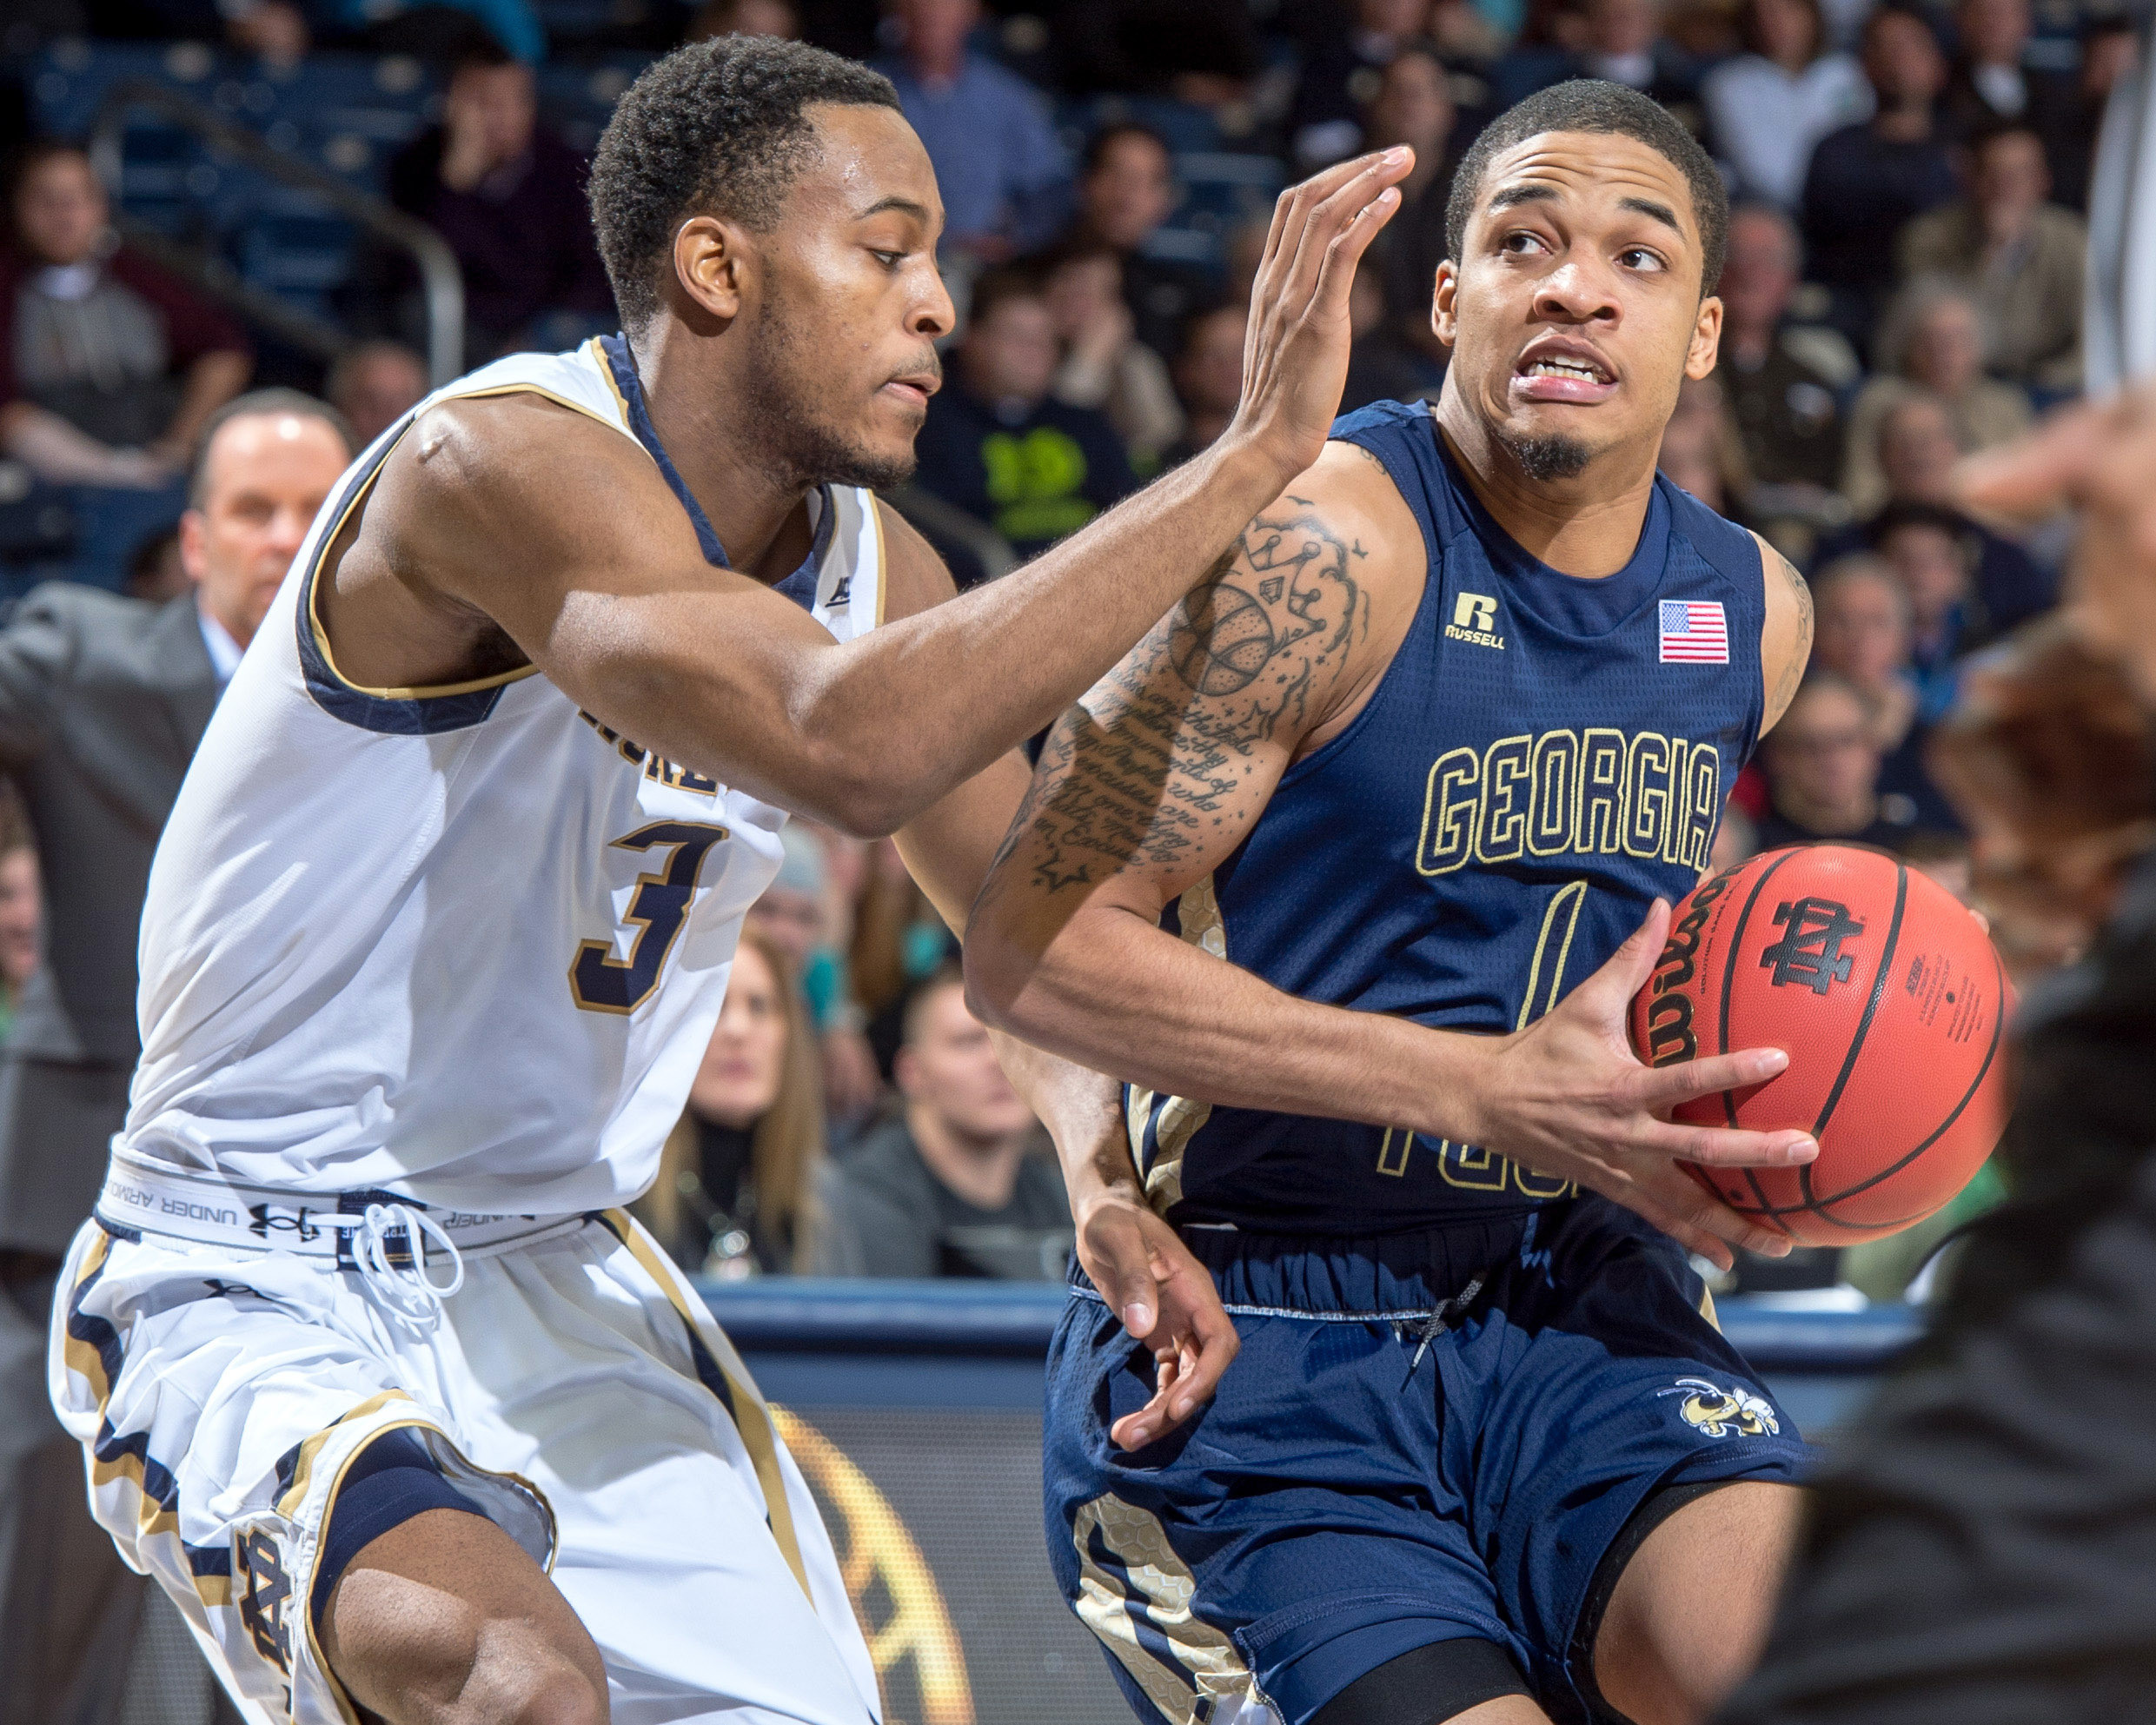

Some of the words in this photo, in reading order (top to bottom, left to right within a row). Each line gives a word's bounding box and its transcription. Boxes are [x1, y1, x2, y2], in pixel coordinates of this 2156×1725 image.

[1445, 625, 1505, 650] RUSSELL
[1181, 710, 1211, 732] the
[1192, 738, 1229, 771] they
[1168, 783, 1224, 813] who
[1212, 778, 1237, 796] of
[1159, 803, 1198, 829] are
[1415, 728, 1720, 876] GEORGIA
[567, 819, 729, 1016] 3
[162, 1197, 236, 1226] UNDER
